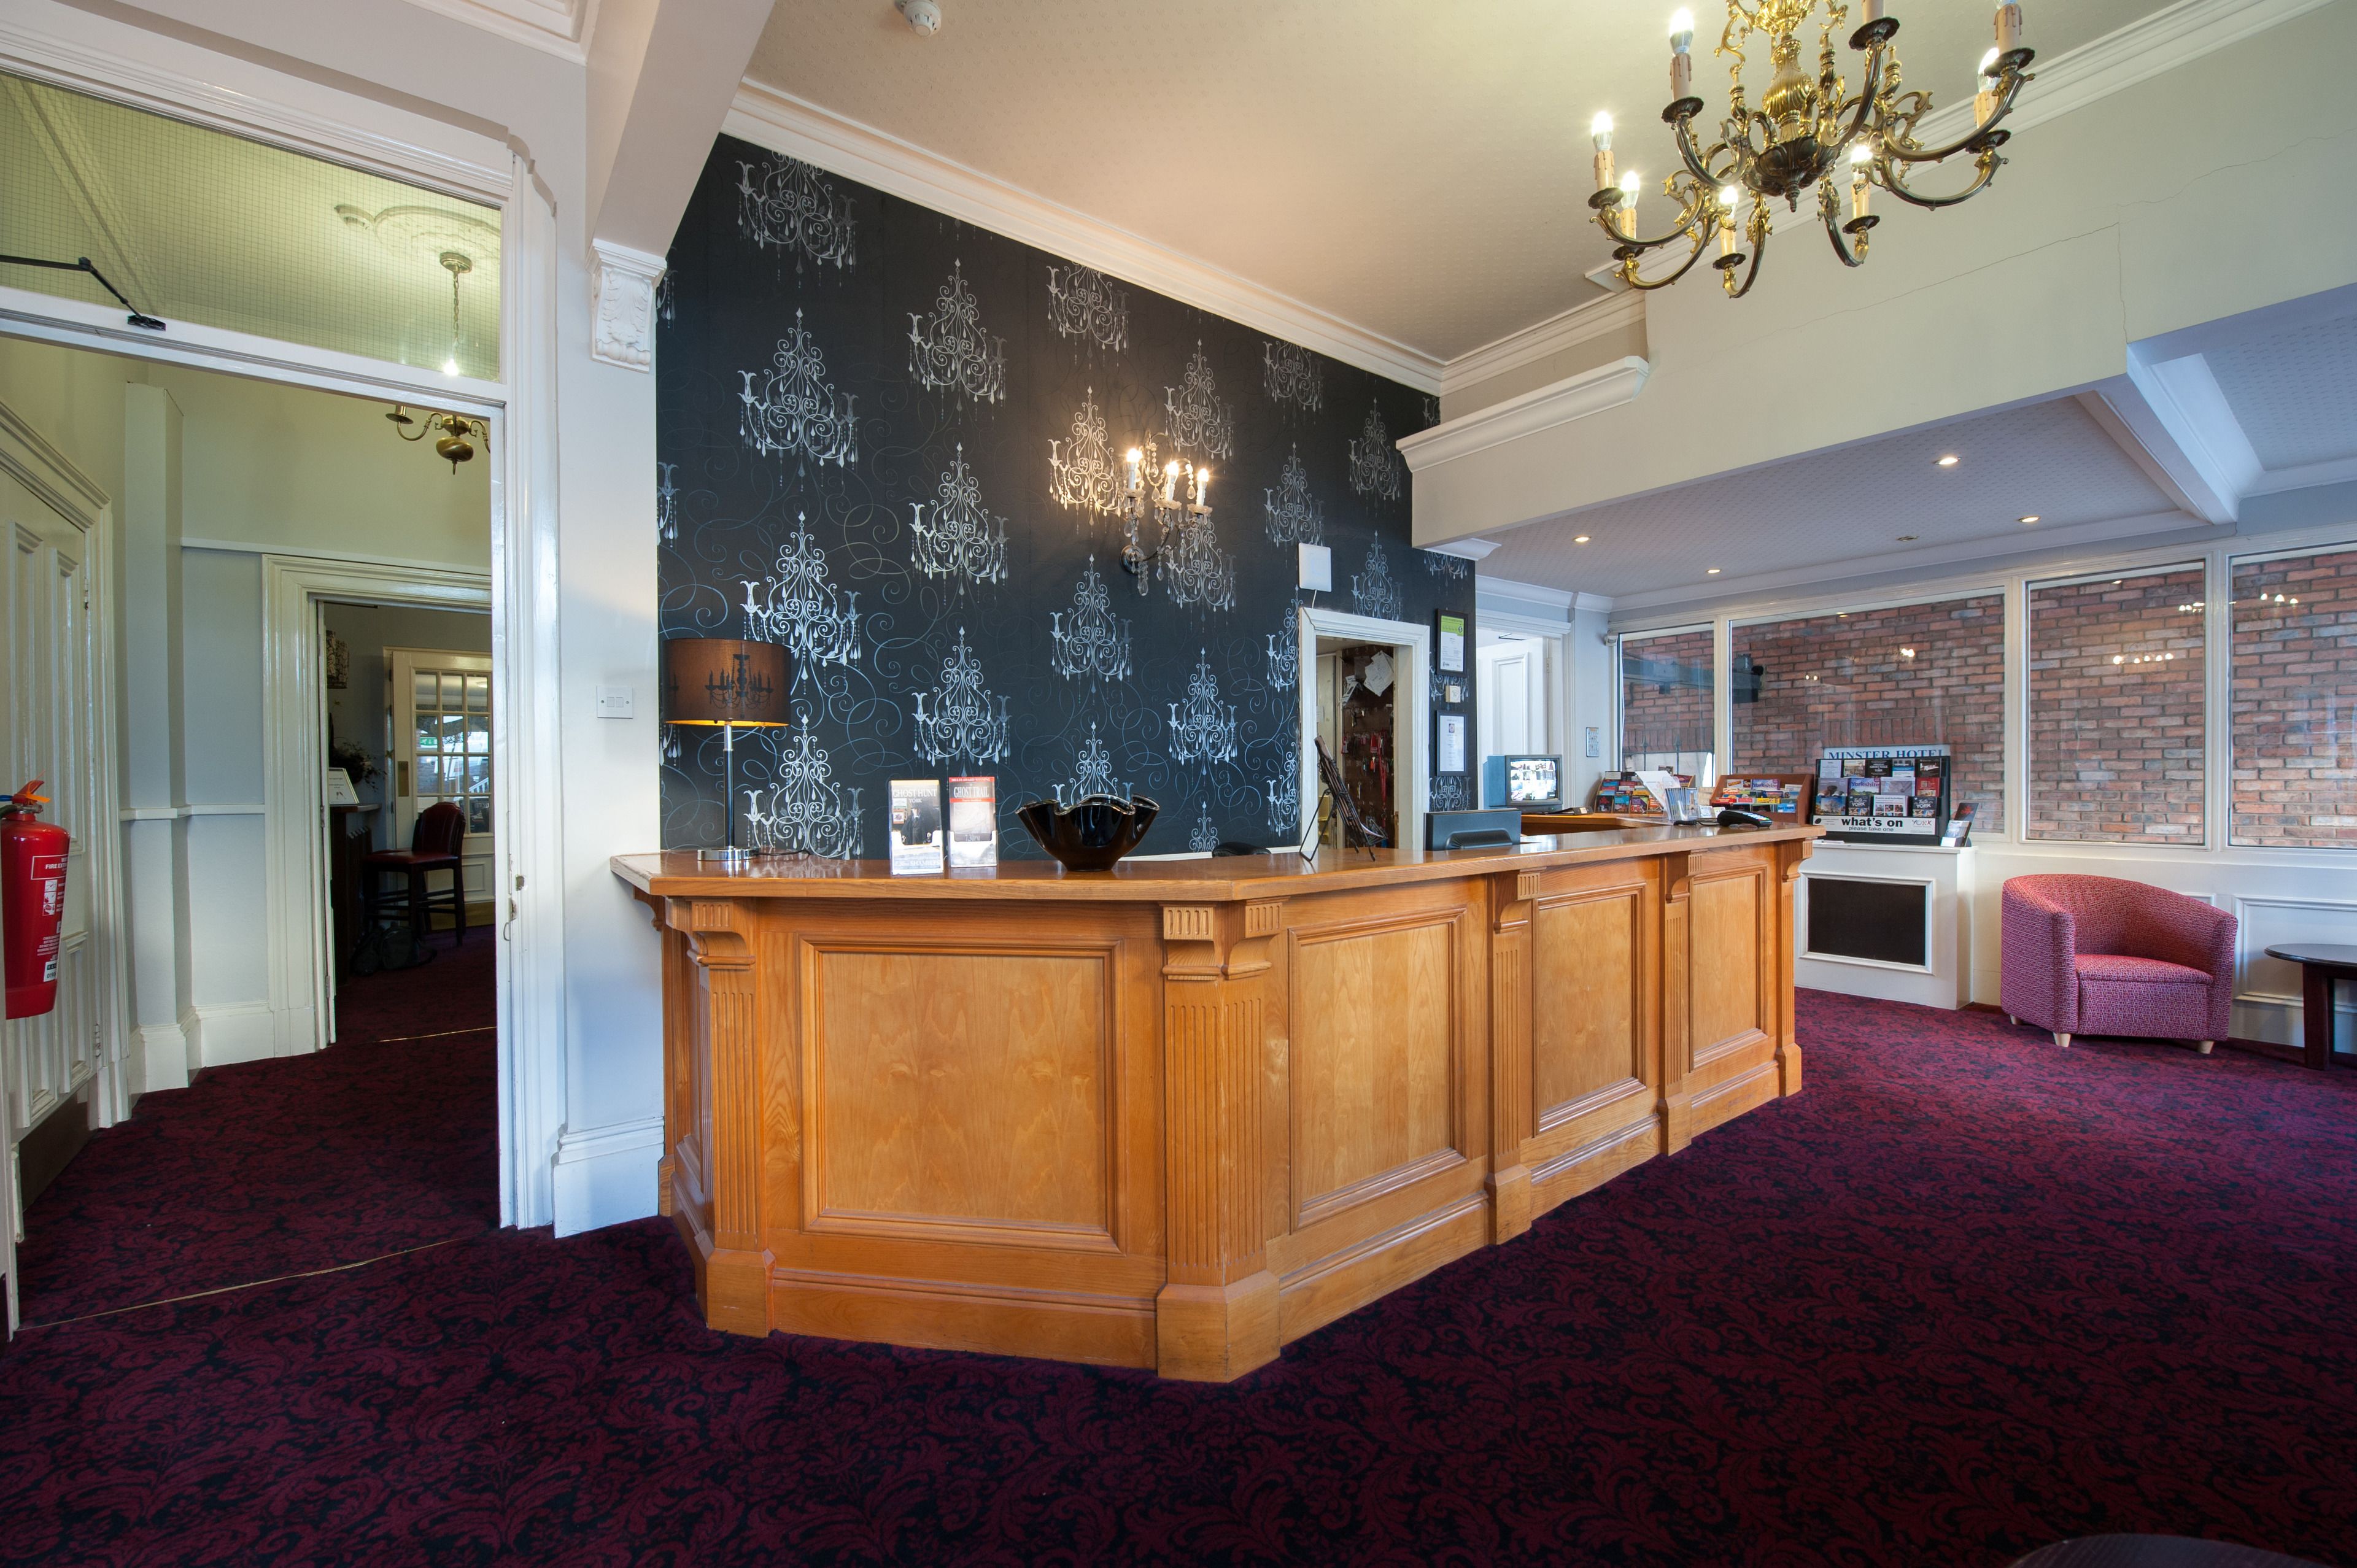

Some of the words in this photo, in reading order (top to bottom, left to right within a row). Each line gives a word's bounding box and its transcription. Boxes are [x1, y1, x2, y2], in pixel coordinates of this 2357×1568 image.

[953, 786, 972, 798] GHOST
[972, 786, 989, 797] TRAIL
[1841, 817, 1882, 827] what's
